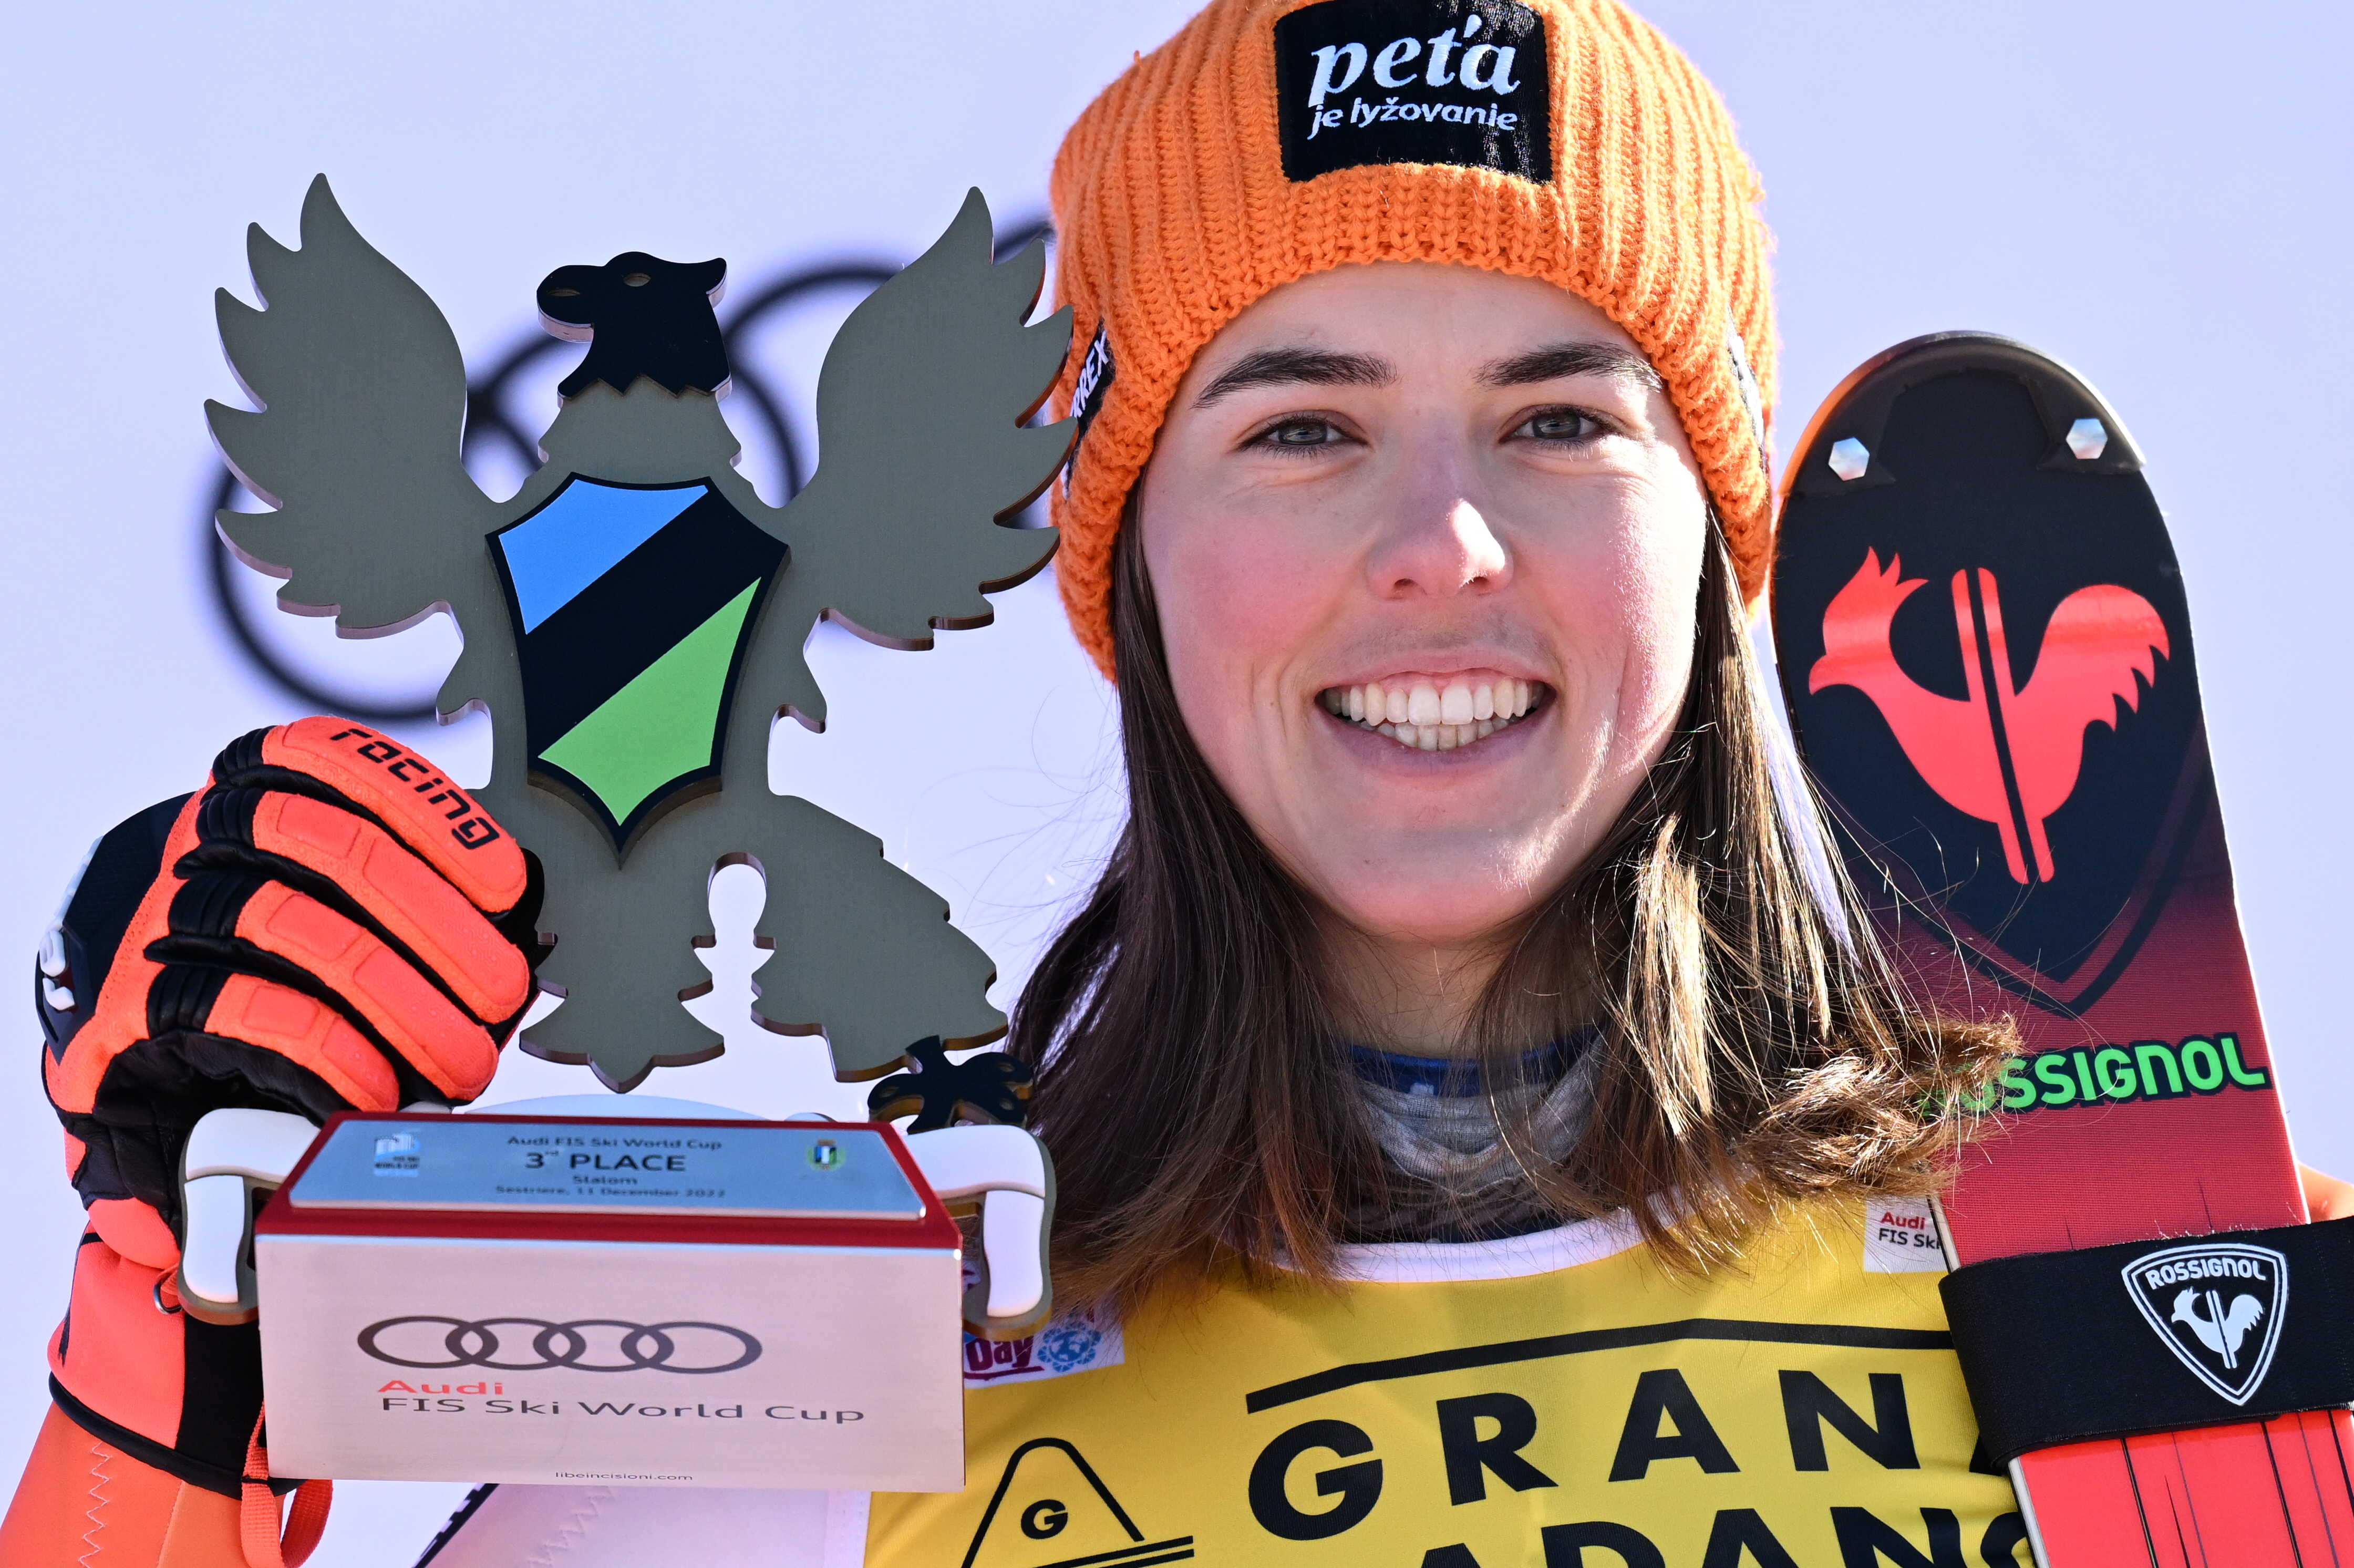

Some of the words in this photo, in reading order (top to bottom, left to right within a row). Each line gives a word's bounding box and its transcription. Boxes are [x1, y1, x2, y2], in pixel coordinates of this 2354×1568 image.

[1307, 105, 1344, 140] je
[1350, 97, 1519, 131] lyžovanie
[1069, 329, 1109, 419] RREX
[330, 728, 500, 850] racing
[507, 1136, 550, 1147] Audi
[554, 1136, 585, 1147] FIS
[591, 1138, 618, 1148] Ski
[623, 1138, 682, 1149] World
[686, 1139, 723, 1151] Cup
[570, 1153, 686, 1172] PLACE
[572, 1174, 638, 1185] Slalom
[1880, 1211, 1926, 1230] Audi
[1878, 1227, 1908, 1245] FIS
[2145, 1258, 2266, 1290] ROSSIGNOL
[377, 1380, 504, 1395] Audi
[383, 1398, 466, 1412] FIS
[486, 1400, 559, 1415] Ski
[577, 1401, 743, 1419] World
[765, 1406, 864, 1424] Cup
[555, 1472, 693, 1481] libeincisioni.com
[1020, 1499, 1068, 1540] G
